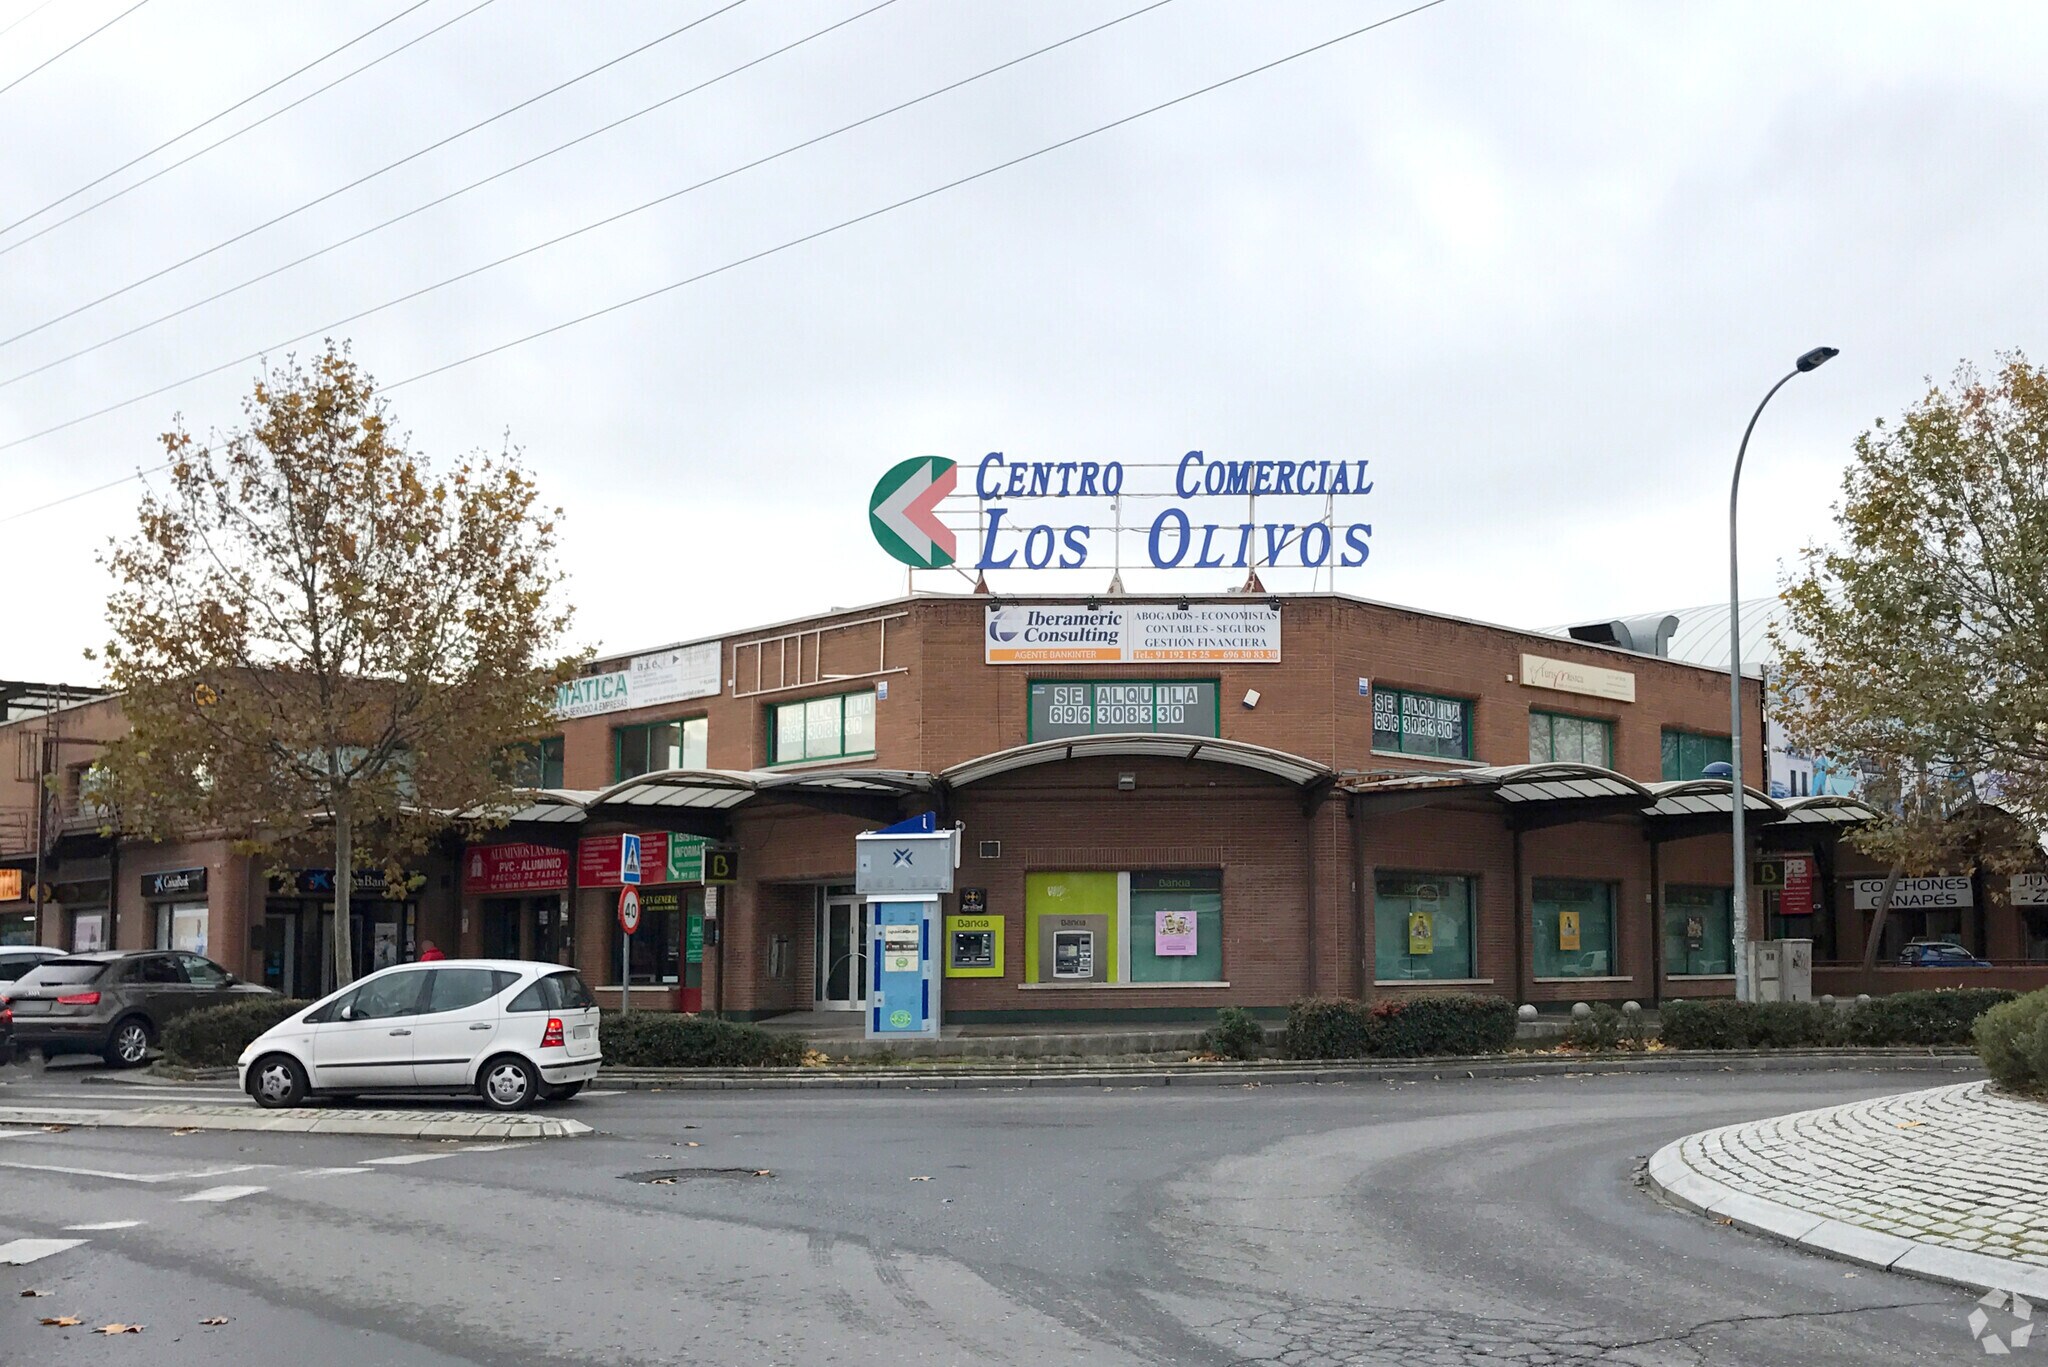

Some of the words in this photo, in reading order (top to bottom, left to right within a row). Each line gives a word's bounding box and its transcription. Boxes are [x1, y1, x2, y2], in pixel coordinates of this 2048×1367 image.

[976, 452, 1123, 500] CENTRO
[1176, 450, 1374, 499] COMERCIAL
[974, 508, 1090, 570] LOS
[1148, 508, 1372, 570] OLIVOS
[1027, 610, 1122, 626] Iberameric
[1135, 612, 1193, 621] ABOGADOS
[1202, 611, 1278, 620] ECONOMISTAS
[1146, 624, 1209, 633] CONTABLES
[1216, 624, 1266, 633] SEGUROS
[1024, 627, 1119, 646] Consulting
[1144, 636, 1195, 647] GESTIÓN
[1198, 638, 1267, 647] FINANCIERA
[1014, 650, 1047, 660] AGENTE
[1049, 650, 1097, 659] BANKINTER
[1156, 651, 1166, 659] 91
[1169, 651, 1184, 659] 192
[1187, 651, 1198, 659] 15
[1200, 651, 1210, 659] 25
[1223, 650, 1239, 659] 696
[1242, 650, 1252, 659] 30
[1254, 650, 1265, 659] 83
[1266, 650, 1277, 659] 30
[1055, 688, 1083, 704] SE
[1098, 687, 1198, 704] ALQUILA
[1050, 706, 1091, 723] 696
[1375, 694, 1394, 713] SE
[1403, 697, 1460, 722] ALQUILA
[1374, 712, 1399, 732] 696
[500, 861, 515, 873] PVC
[521, 858, 562, 871] ALUMINIO
[1158, 878, 1191, 888] Bankia
[1860, 878, 1969, 893] COCHONES
[625, 902, 637, 919] 40
[958, 919, 989, 928] Bankia
[1060, 919, 1087, 927] Bankia
